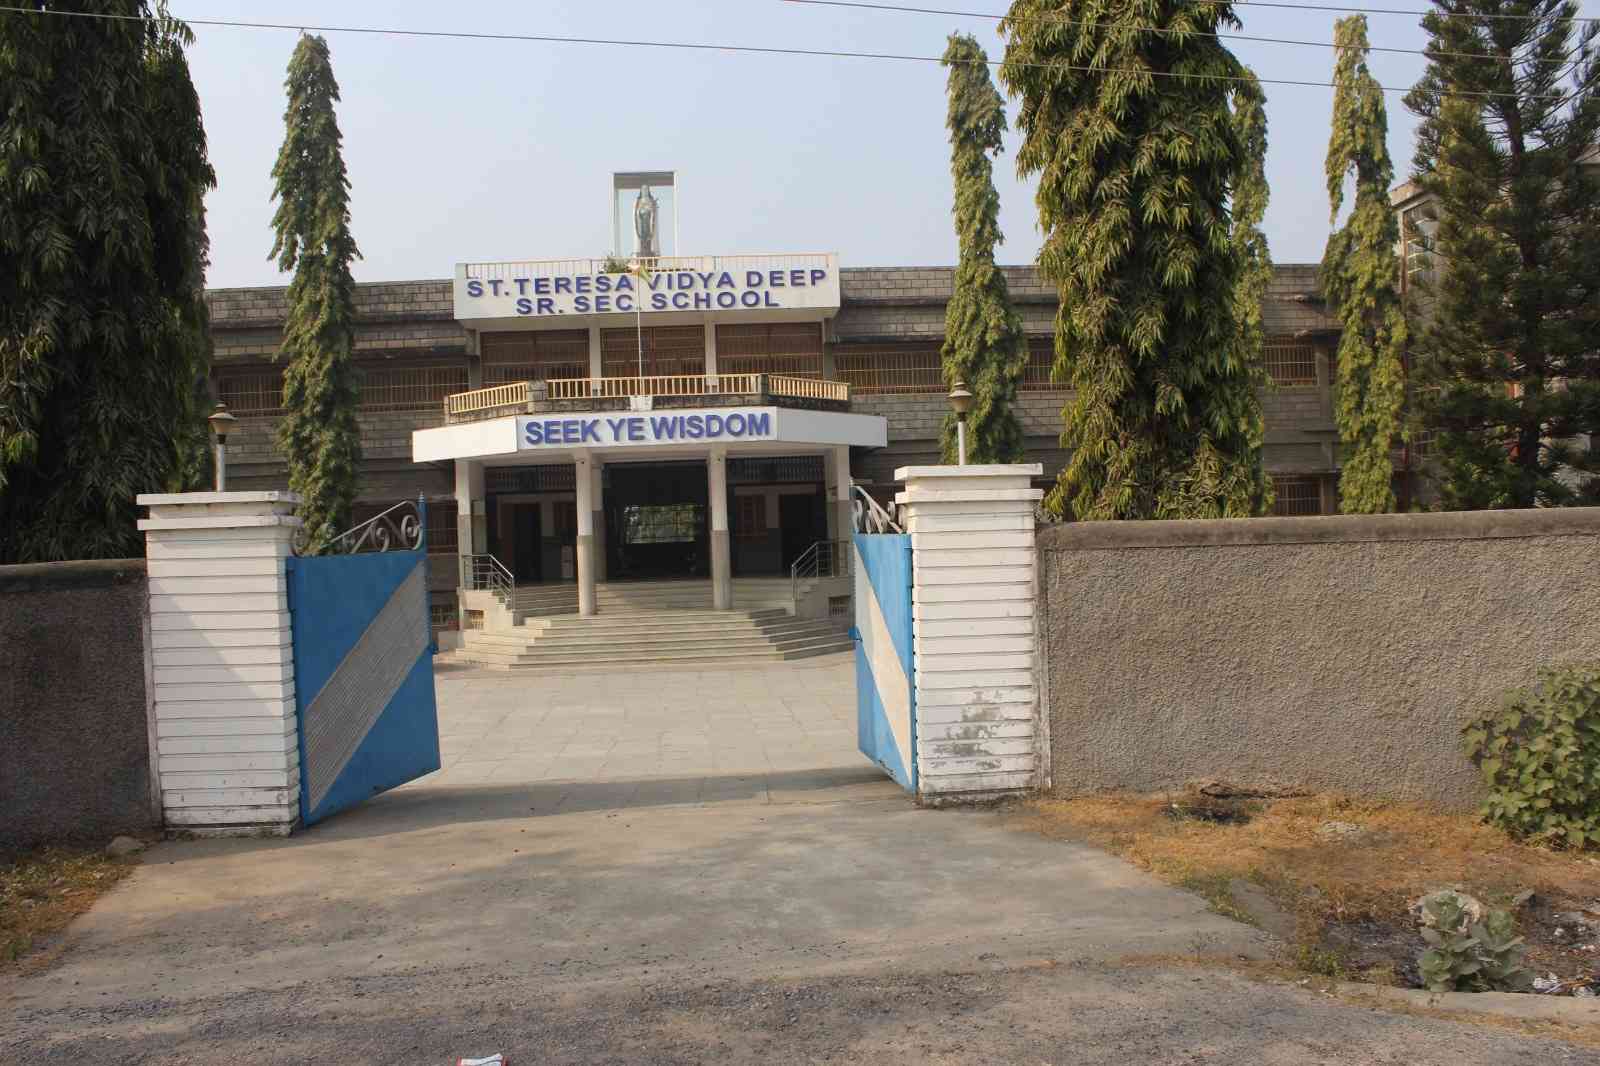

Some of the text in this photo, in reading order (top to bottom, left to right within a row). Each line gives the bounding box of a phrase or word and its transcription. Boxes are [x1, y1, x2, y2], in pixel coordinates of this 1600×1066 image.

[649, 271, 735, 291] VIDYA
[746, 269, 827, 288] DEEP
[516, 297, 564, 315] SR.
[651, 291, 780, 310] SCHOOL
[525, 412, 770, 445] SEEK YE WISDOM
